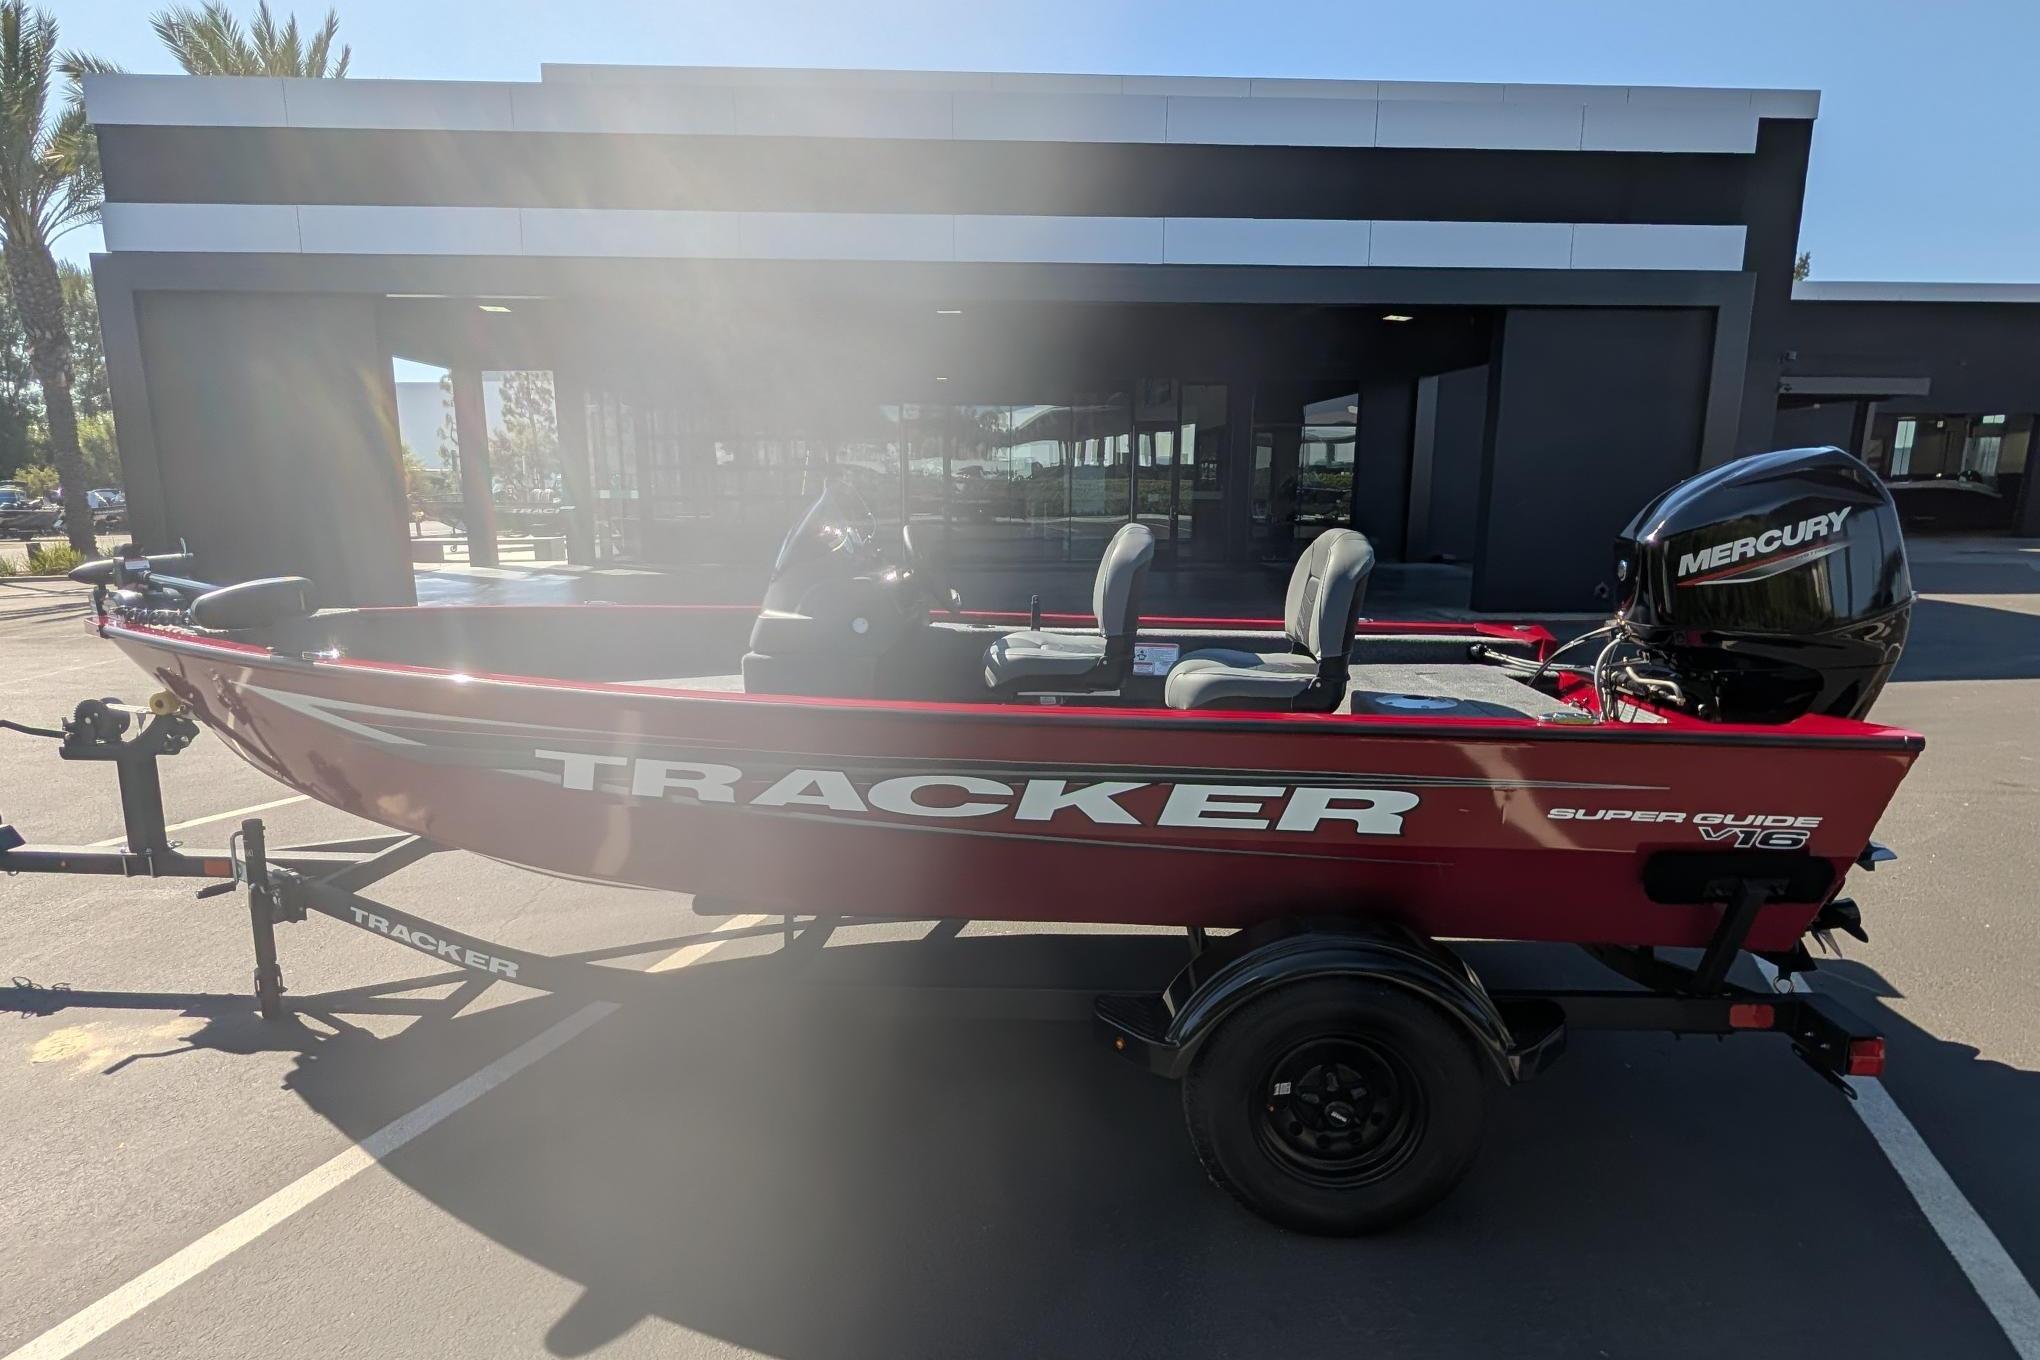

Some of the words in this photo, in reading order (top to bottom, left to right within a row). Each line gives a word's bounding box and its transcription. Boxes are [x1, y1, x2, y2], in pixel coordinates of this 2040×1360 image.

[1677, 505, 1852, 577] MERCURY
[534, 748, 1420, 835] TRACKER
[1547, 808, 1687, 824] SUPER
[1693, 813, 1823, 828] GUIDE
[1698, 826, 1811, 849] V16
[350, 906, 520, 978] TRACKER
